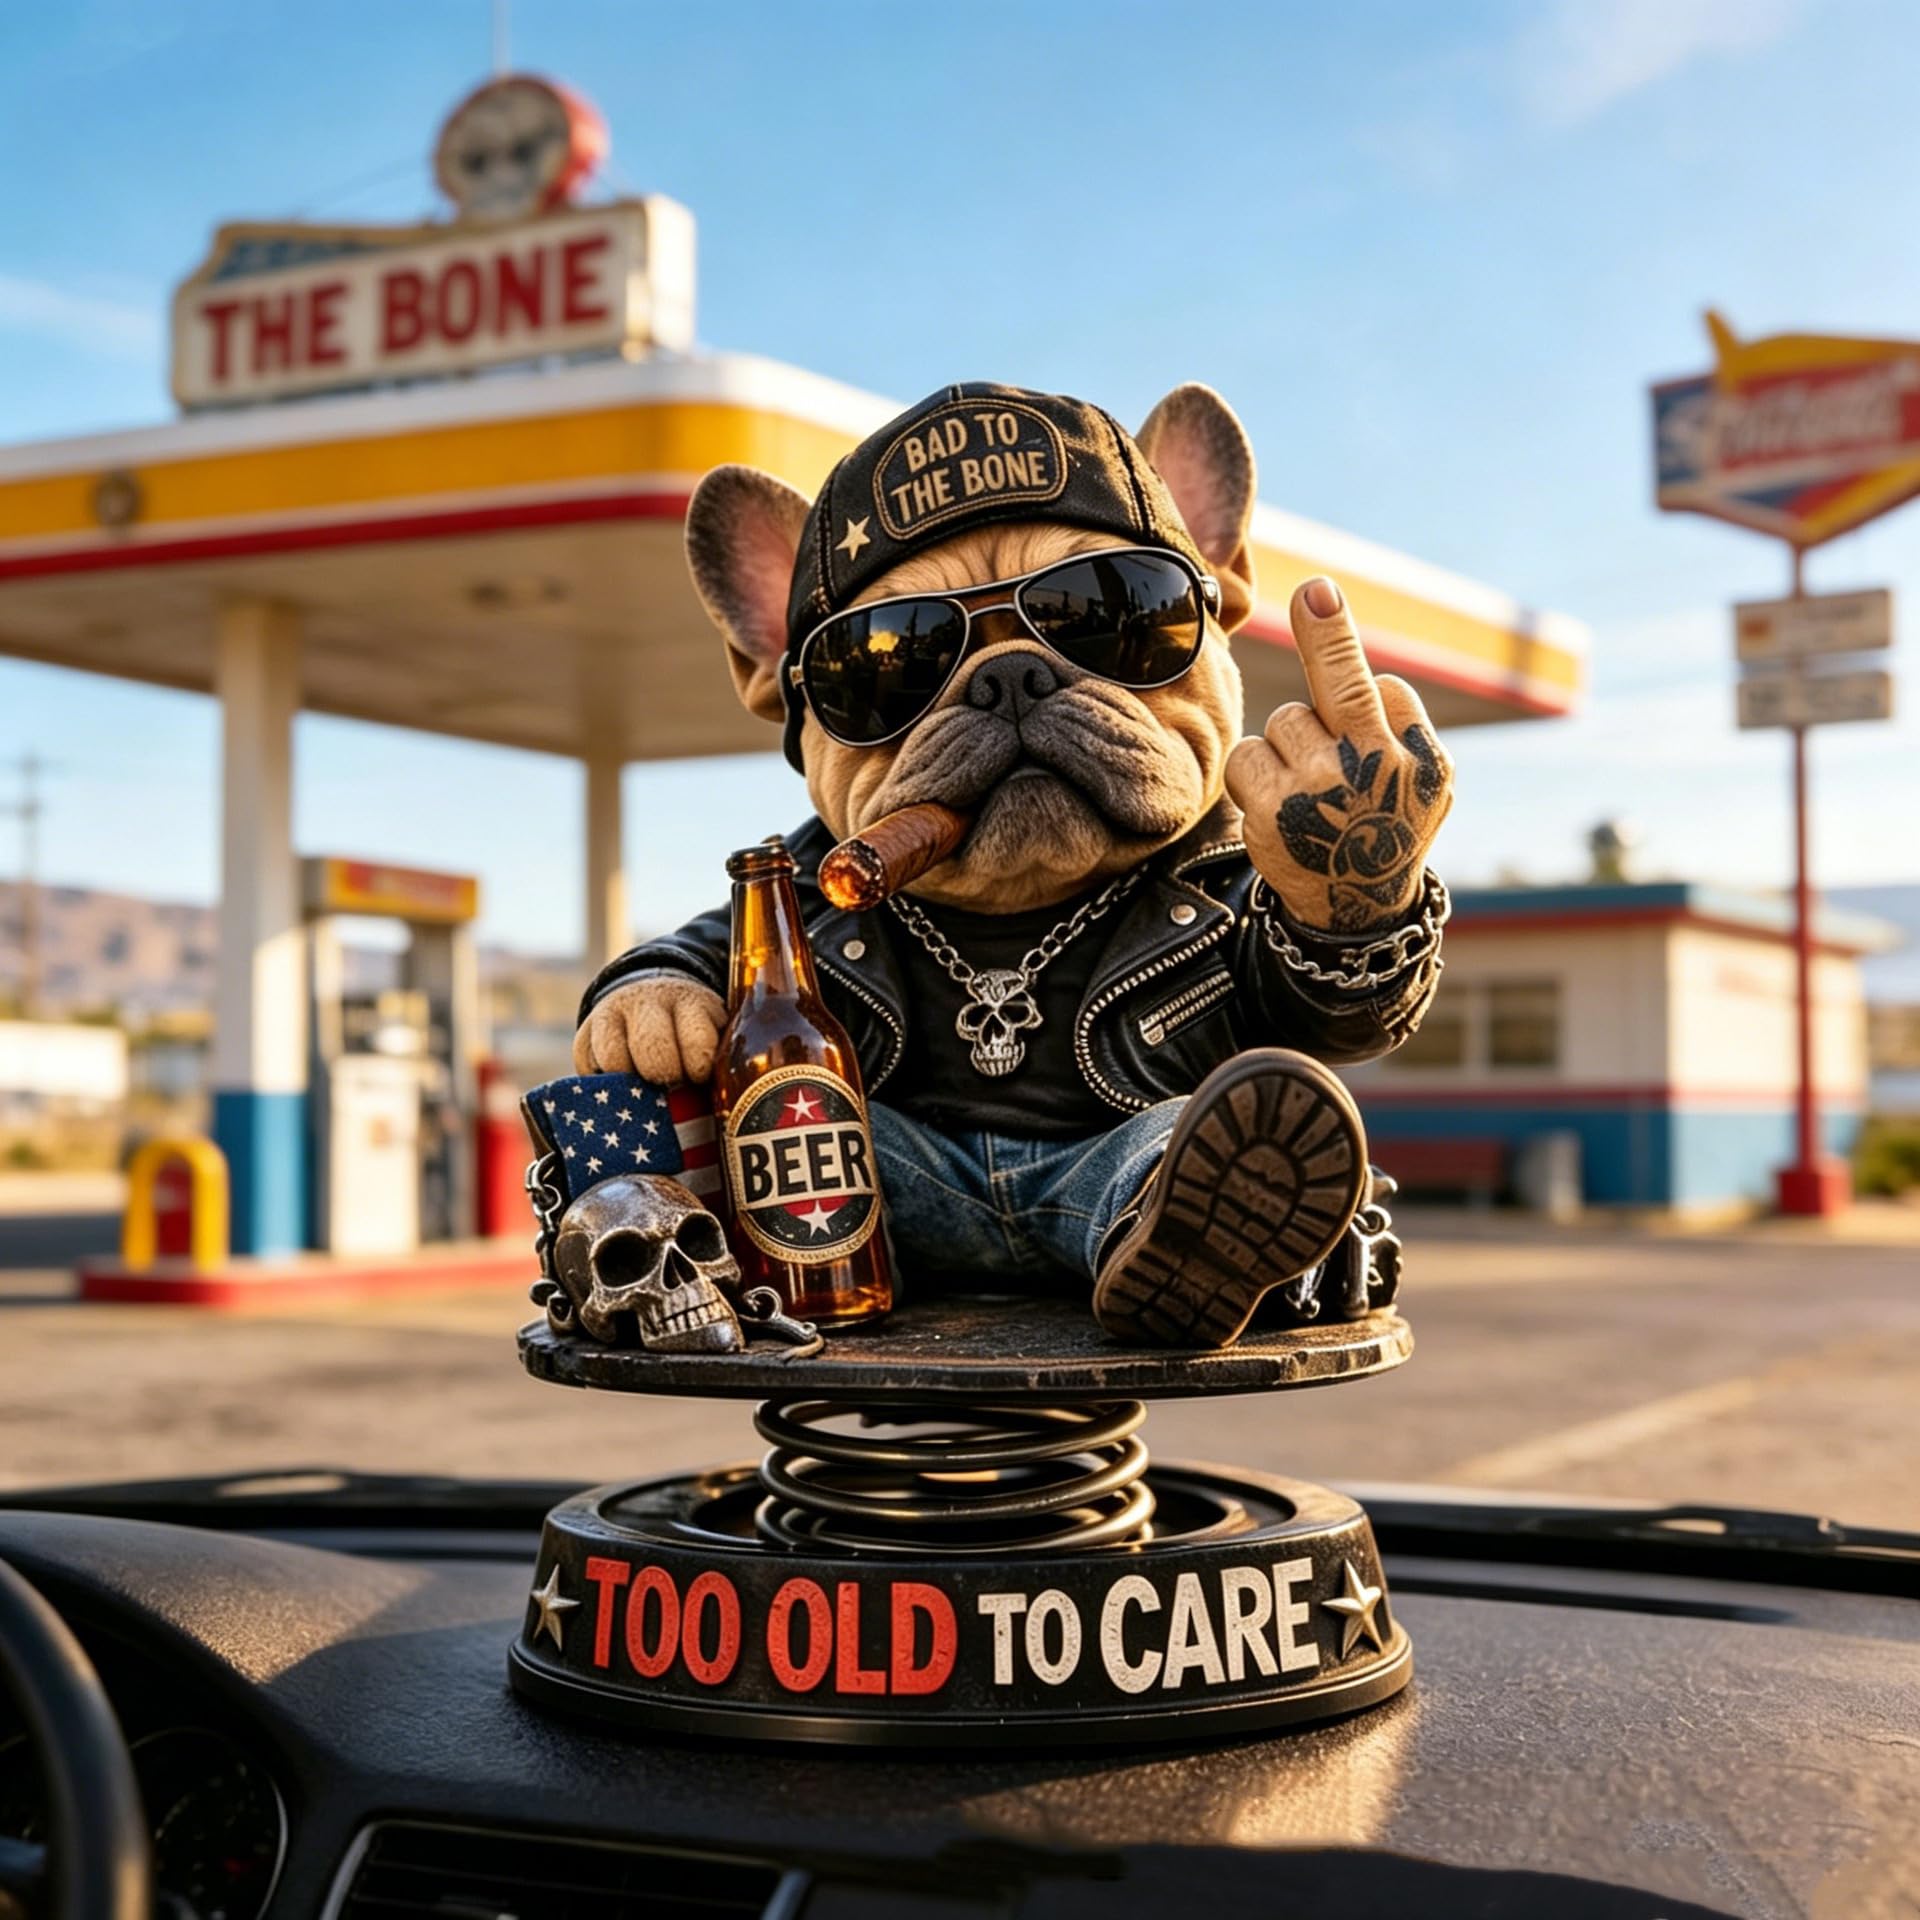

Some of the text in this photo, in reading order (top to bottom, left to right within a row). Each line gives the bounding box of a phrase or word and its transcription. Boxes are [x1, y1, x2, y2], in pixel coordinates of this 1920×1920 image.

[200, 234, 614, 384] THE BONE
[904, 412, 1019, 472] BAD TO
[891, 450, 1049, 524] THE BONE
[739, 1130, 872, 1203] BEER
[585, 1556, 1320, 1695] TOO OLD TO CARE
